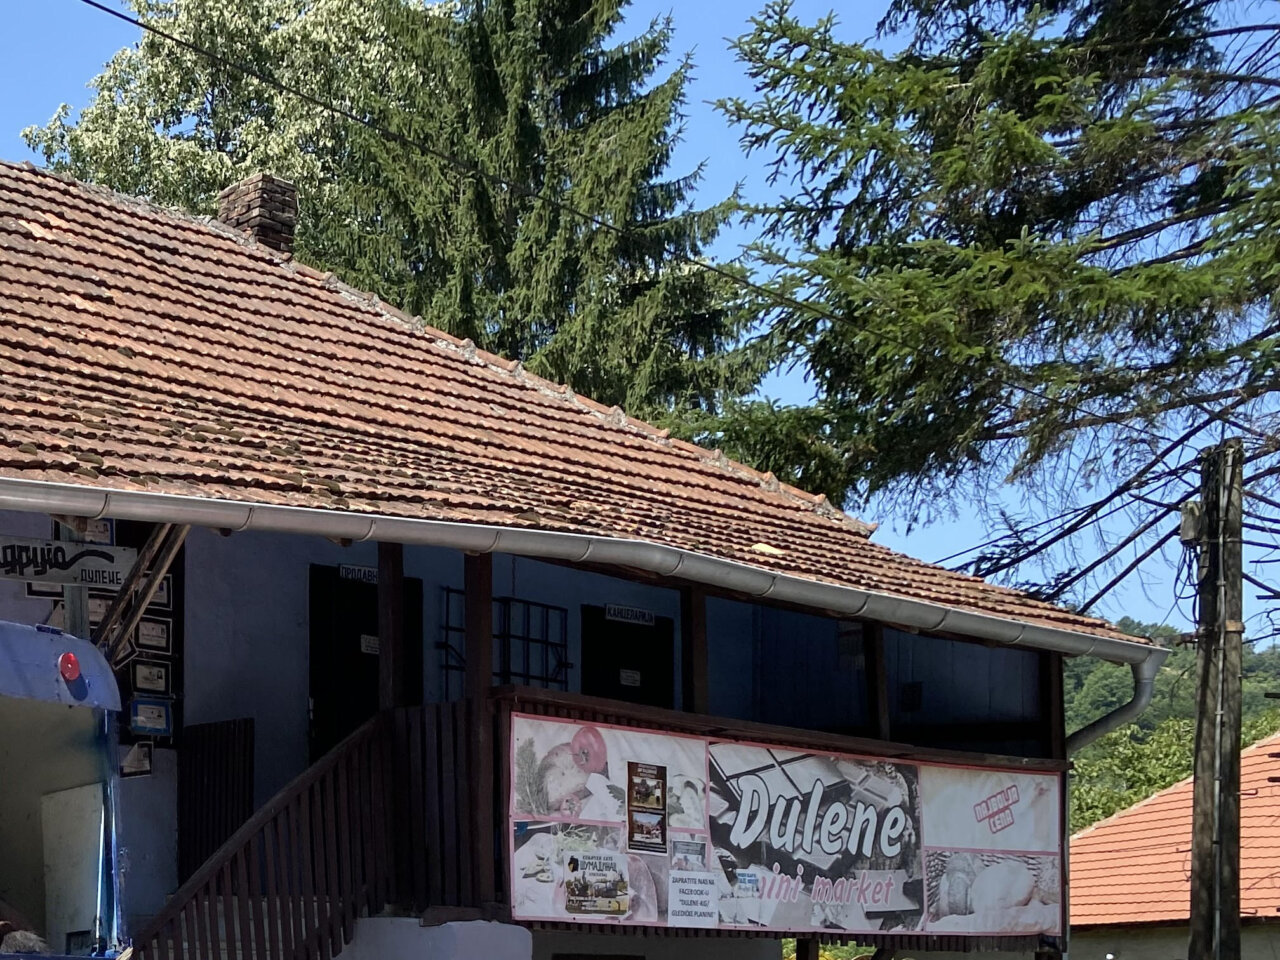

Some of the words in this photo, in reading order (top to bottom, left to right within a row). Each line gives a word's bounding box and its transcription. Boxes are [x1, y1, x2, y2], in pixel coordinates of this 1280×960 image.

[80, 569, 122, 585] ДУЛЕНЕ
[342, 567, 378, 583] ПРОДАВН
[975, 786, 1019, 821] NAJBOLJA
[729, 774, 906, 858] Dulene
[990, 809, 1014, 833] CENA
[672, 877, 697, 885] ZAPRATITE
[811, 870, 895, 904] market
